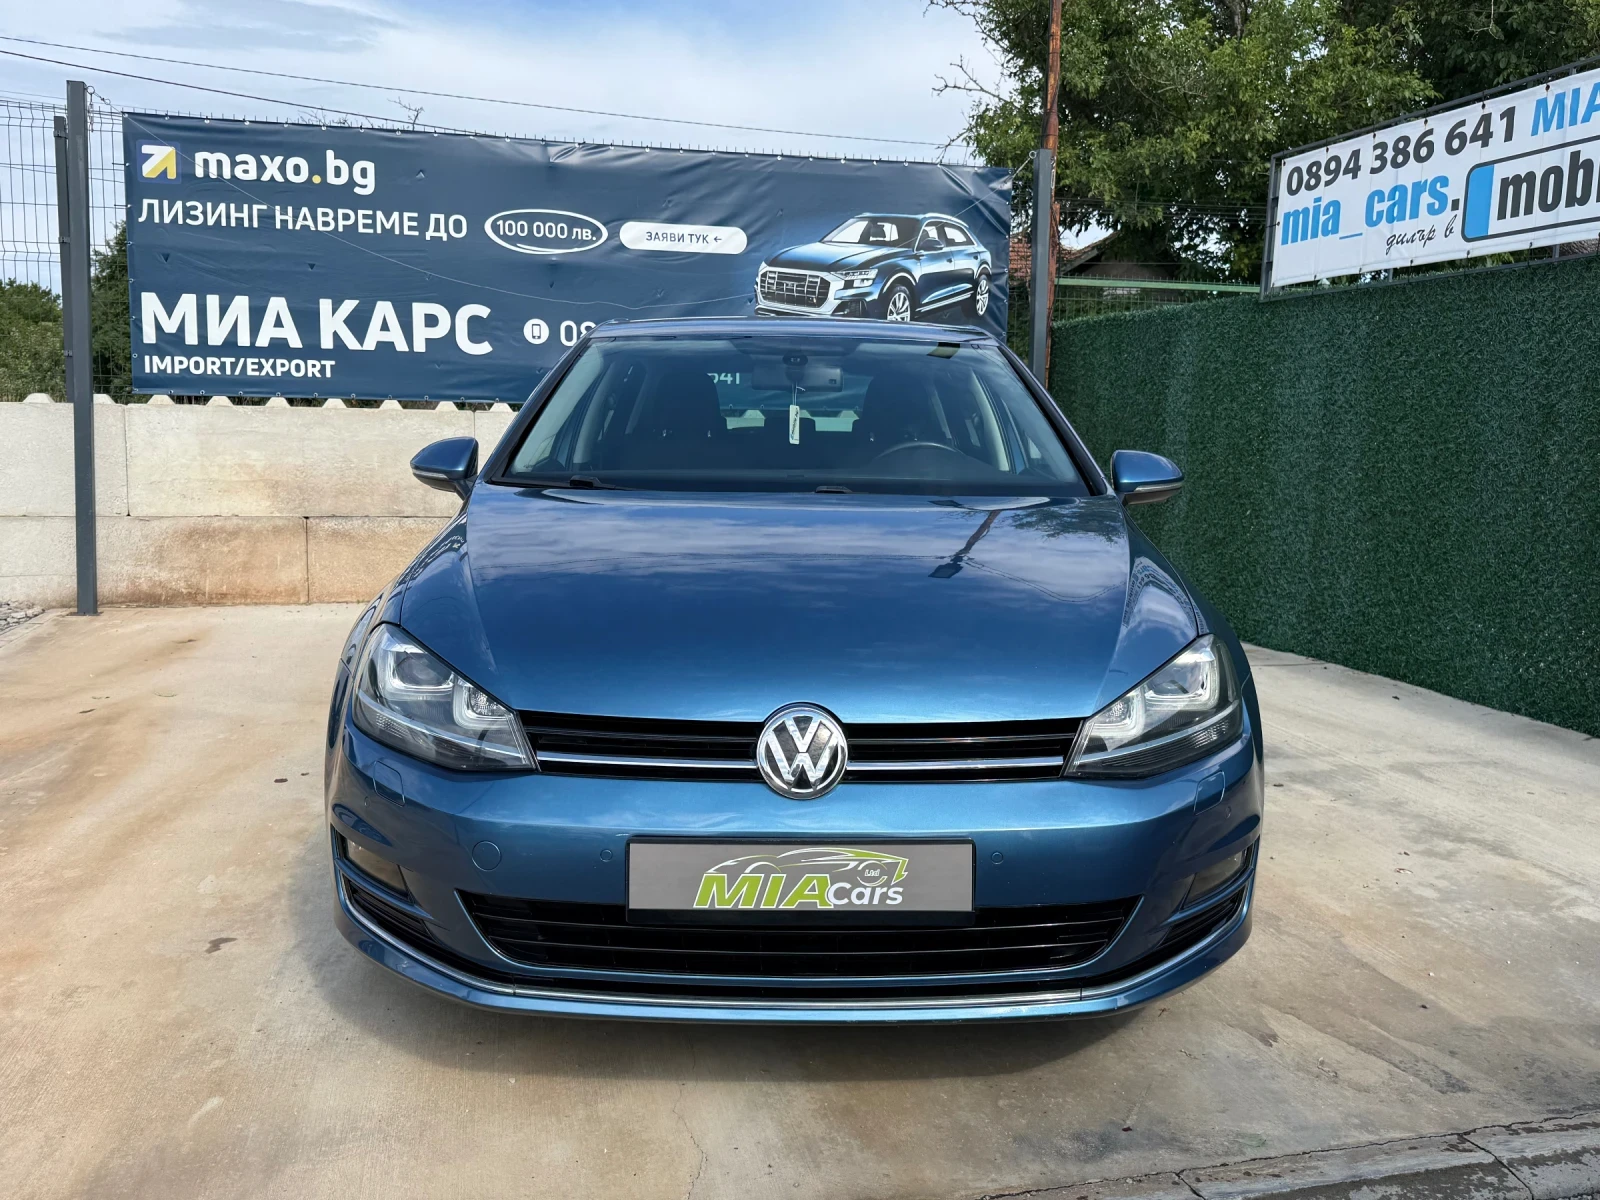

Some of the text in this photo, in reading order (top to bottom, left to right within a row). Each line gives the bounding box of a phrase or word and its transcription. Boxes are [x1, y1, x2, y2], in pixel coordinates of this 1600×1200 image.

[1286, 149, 1362, 196] 0894
[1369, 128, 1435, 175] 386
[1444, 106, 1517, 156] 641
[194, 149, 376, 196] maxo.bg
[138, 198, 468, 242] ЛИЗИНГ НАВРЕМЕ ДО
[496, 219, 598, 242] 100 000 лв.
[645, 230, 710, 244] ЗАЯВИ ТУК
[140, 291, 493, 356] МИА КАРС
[144, 355, 336, 379] IMPORT/EXPORT
[693, 873, 904, 909] MIA Cars
